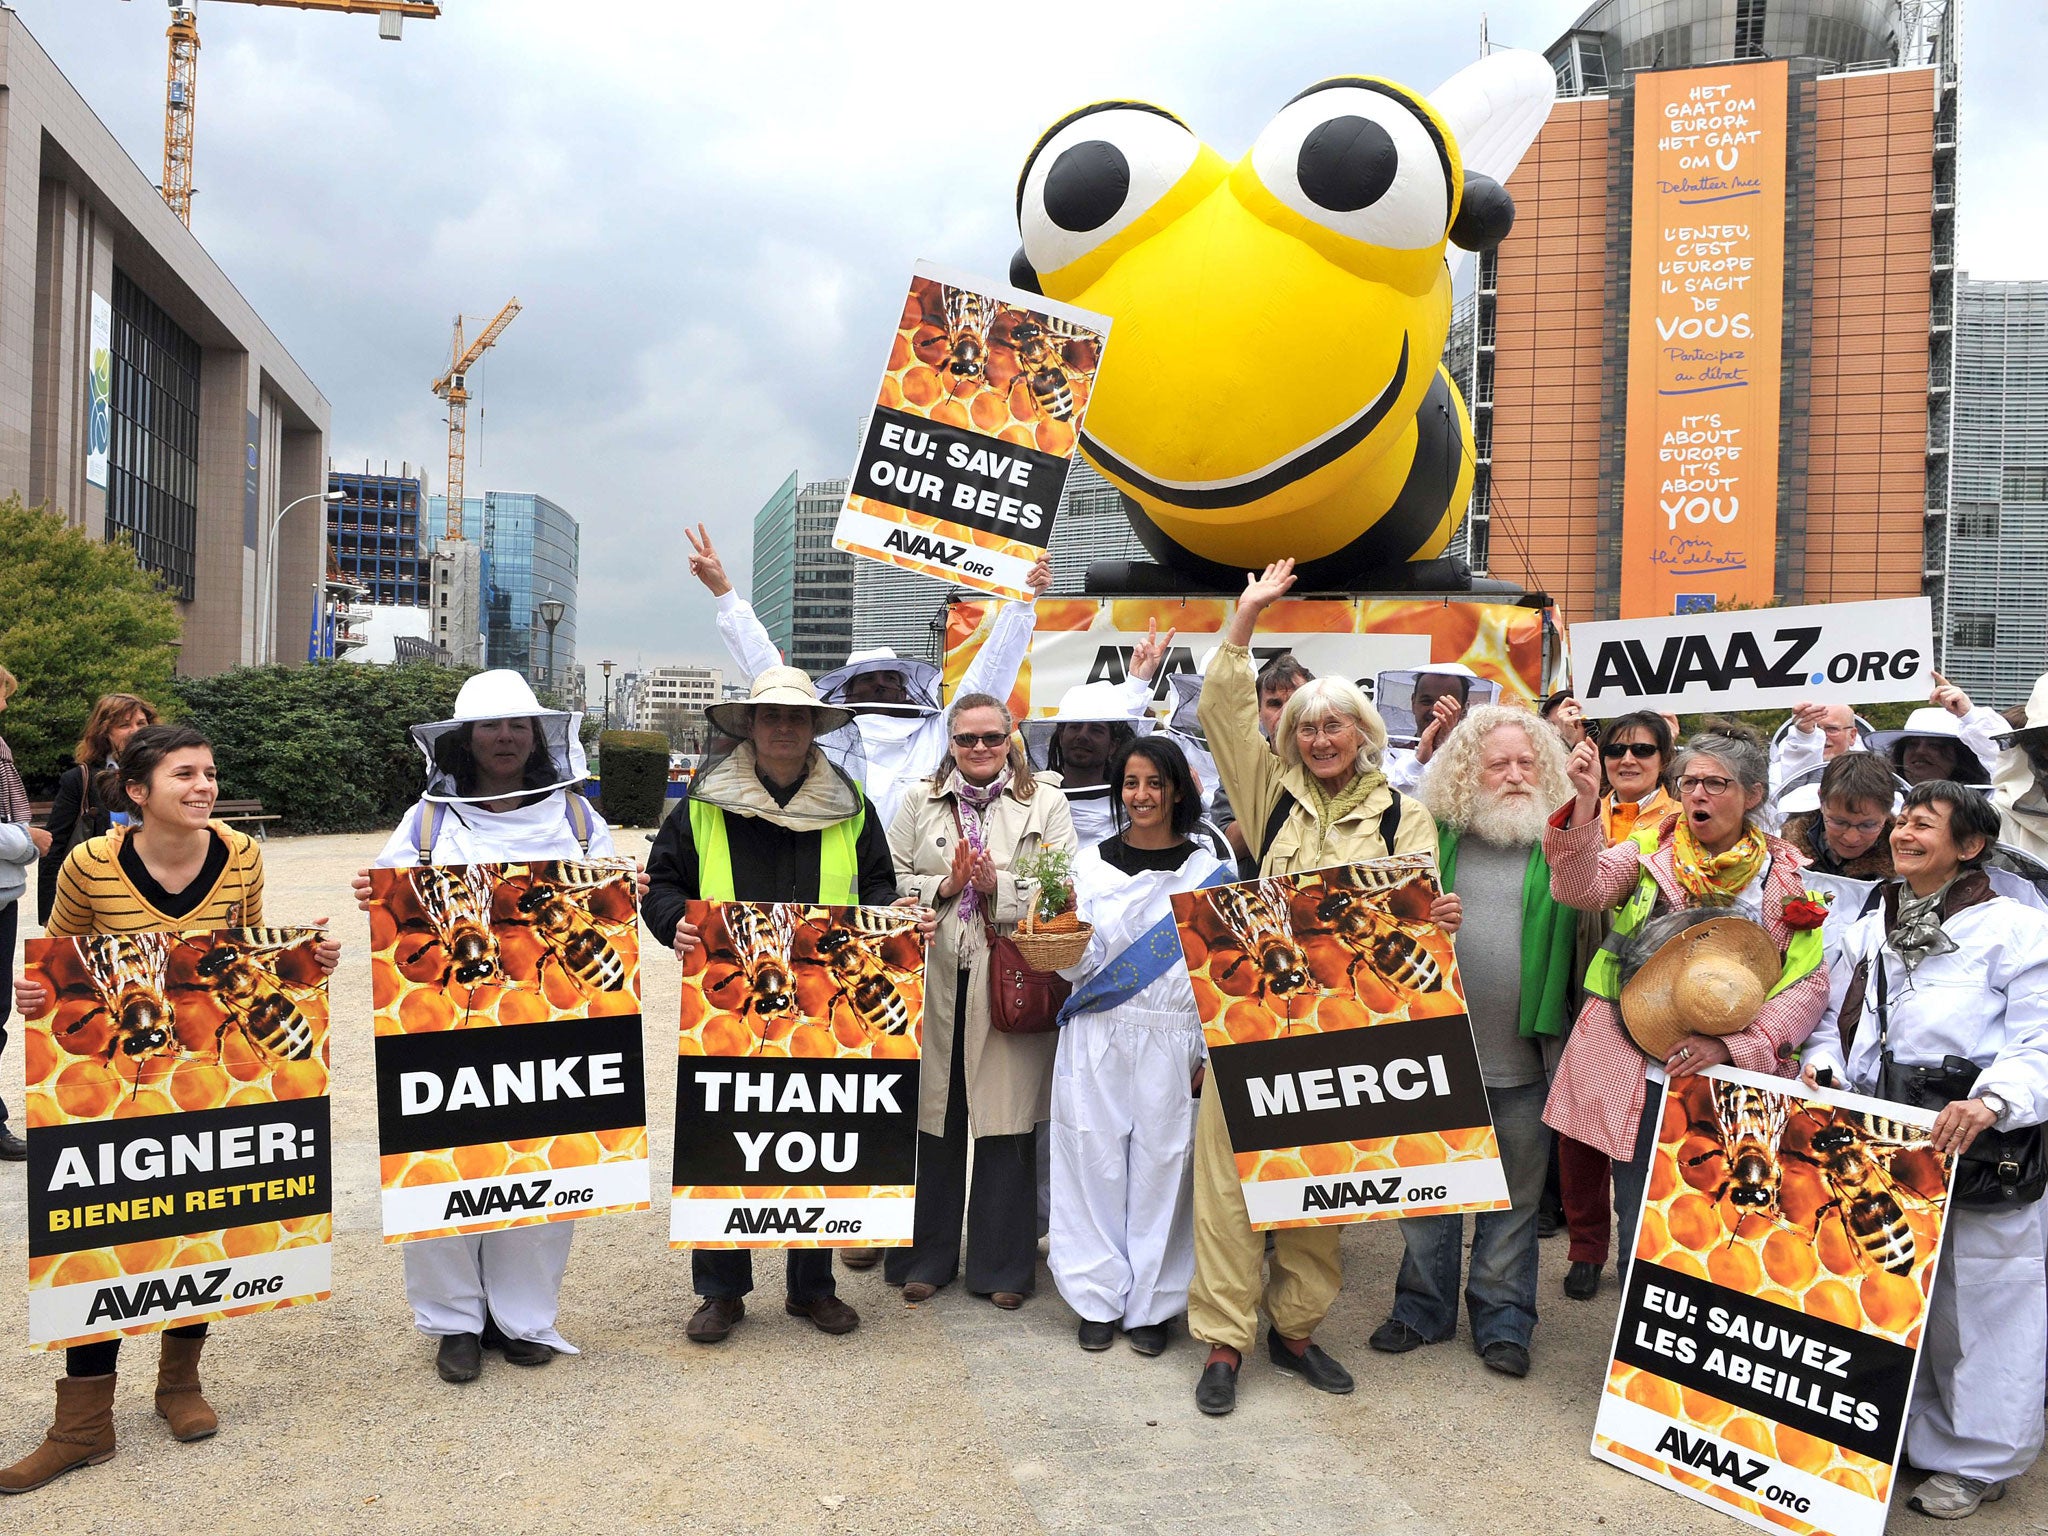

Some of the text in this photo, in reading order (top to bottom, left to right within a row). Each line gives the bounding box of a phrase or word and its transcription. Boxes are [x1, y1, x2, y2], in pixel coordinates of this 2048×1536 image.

[1689, 84, 1731, 100] HET
[1664, 98, 1756, 118] GAAT OM
[1670, 114, 1748, 133] EUROPA
[1658, 130, 1761, 151] HET GAAT
[1679, 146, 1739, 171] OM U
[1676, 240, 1738, 256] C'EST
[1658, 257, 1755, 275] L'EUROPE
[1661, 275, 1751, 293] IL S'AGIT
[1690, 296, 1720, 313] DE
[1663, 347, 1745, 364] Participez
[1675, 366, 1748, 381] au débat
[1681, 413, 1722, 429] IT'S
[1662, 428, 1741, 445] ABOUT
[879, 422, 1033, 488] EU: SAVE
[1659, 446, 1742, 462] EUROPE
[1680, 462, 1720, 477] IT'S
[869, 460, 1044, 530] OUR BEES
[1661, 477, 1739, 494] ABOUT
[1660, 495, 1739, 530] YOU
[883, 529, 994, 577] AVAAZ.ORG
[1649, 549, 1678, 565] the
[1669, 535, 1713, 554] Join
[1586, 626, 1920, 699] AVAAZ.ORG
[399, 1052, 625, 1116] DANKE
[694, 1071, 903, 1114] THANK
[1245, 1054, 1451, 1118] MERCI
[47, 1121, 315, 1192] AIGNER:
[732, 1131, 859, 1173] YOU
[48, 1174, 316, 1232] BIENEN RETTEN!
[443, 1179, 594, 1221] AVAAZ.ORG
[1302, 1176, 1448, 1212] AVAAZ.ORG
[724, 1207, 862, 1234] AVAAZ.ORG
[85, 1267, 284, 1326] AVAAZ.ORG
[1642, 1283, 1852, 1379] EU: SAUVEZ
[1634, 1321, 1880, 1433] LES ABEILLES
[1654, 1426, 1811, 1514] AVAAZ.ORG
